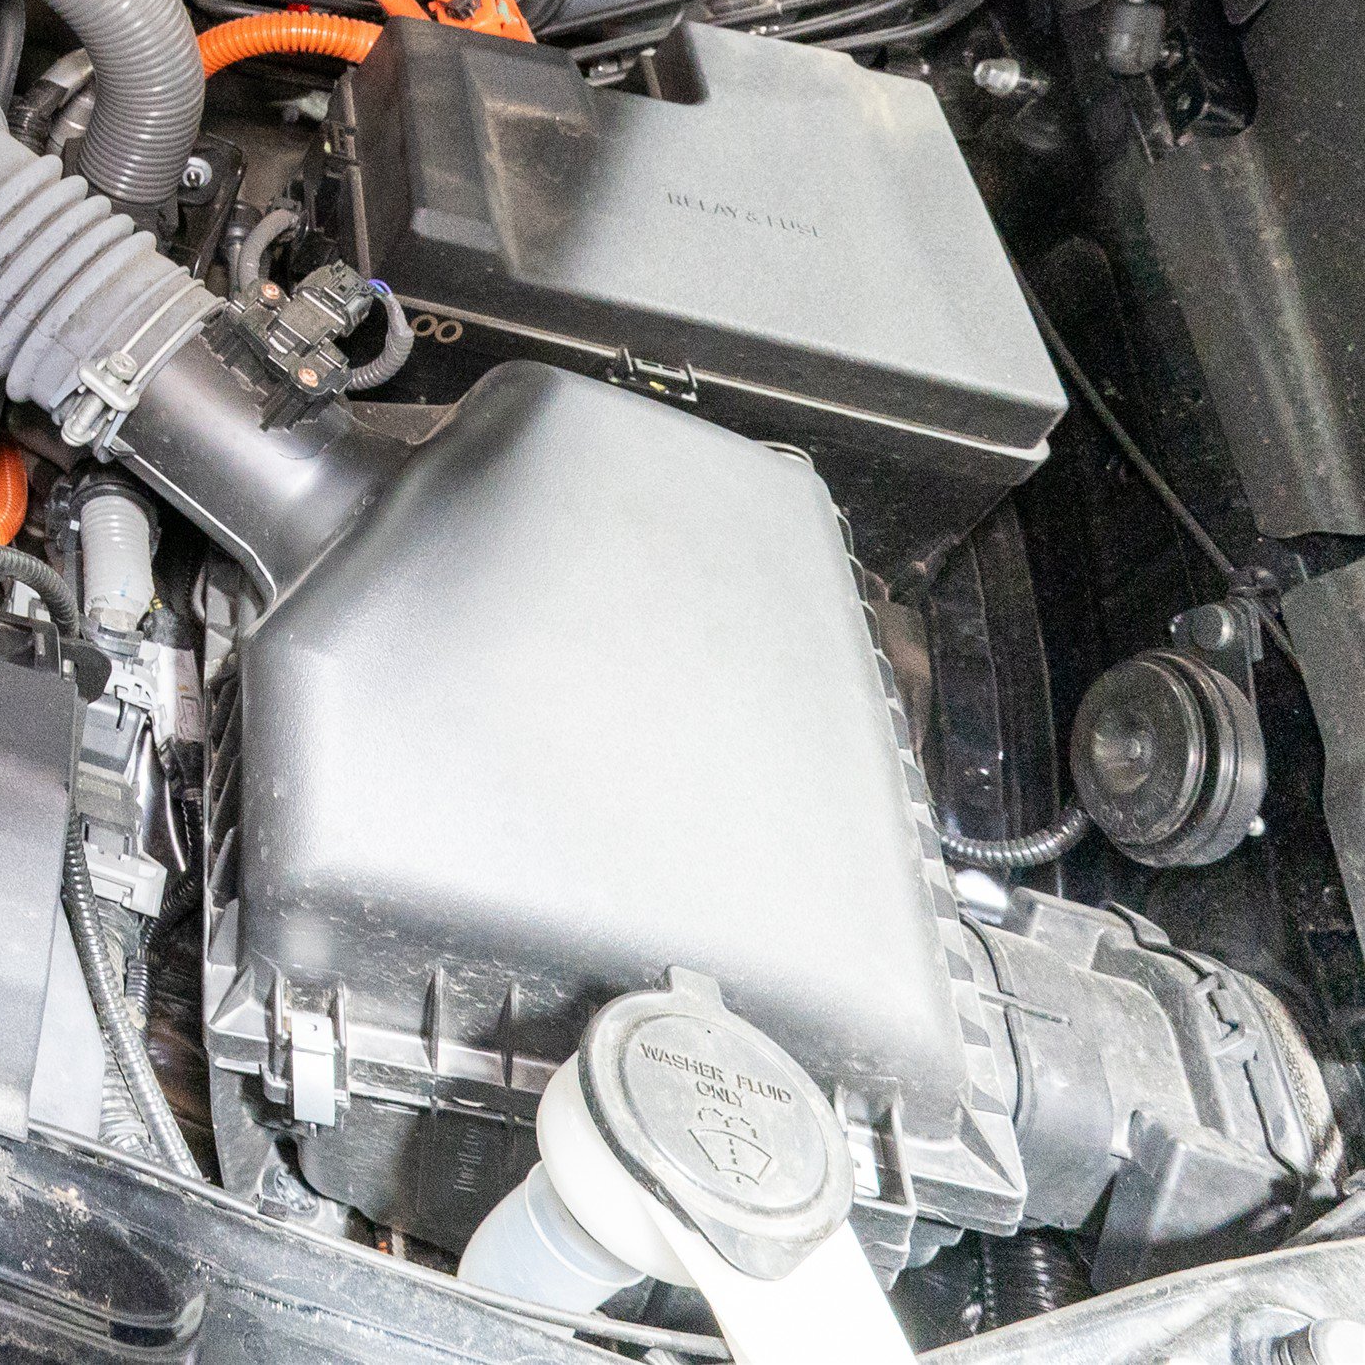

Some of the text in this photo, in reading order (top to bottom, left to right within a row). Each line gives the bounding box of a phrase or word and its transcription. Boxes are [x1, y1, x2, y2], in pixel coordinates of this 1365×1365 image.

[668, 192, 737, 219] RELAY
[640, 1043, 792, 1104] WASHER FLUID
[696, 1081, 744, 1108] ONLY
